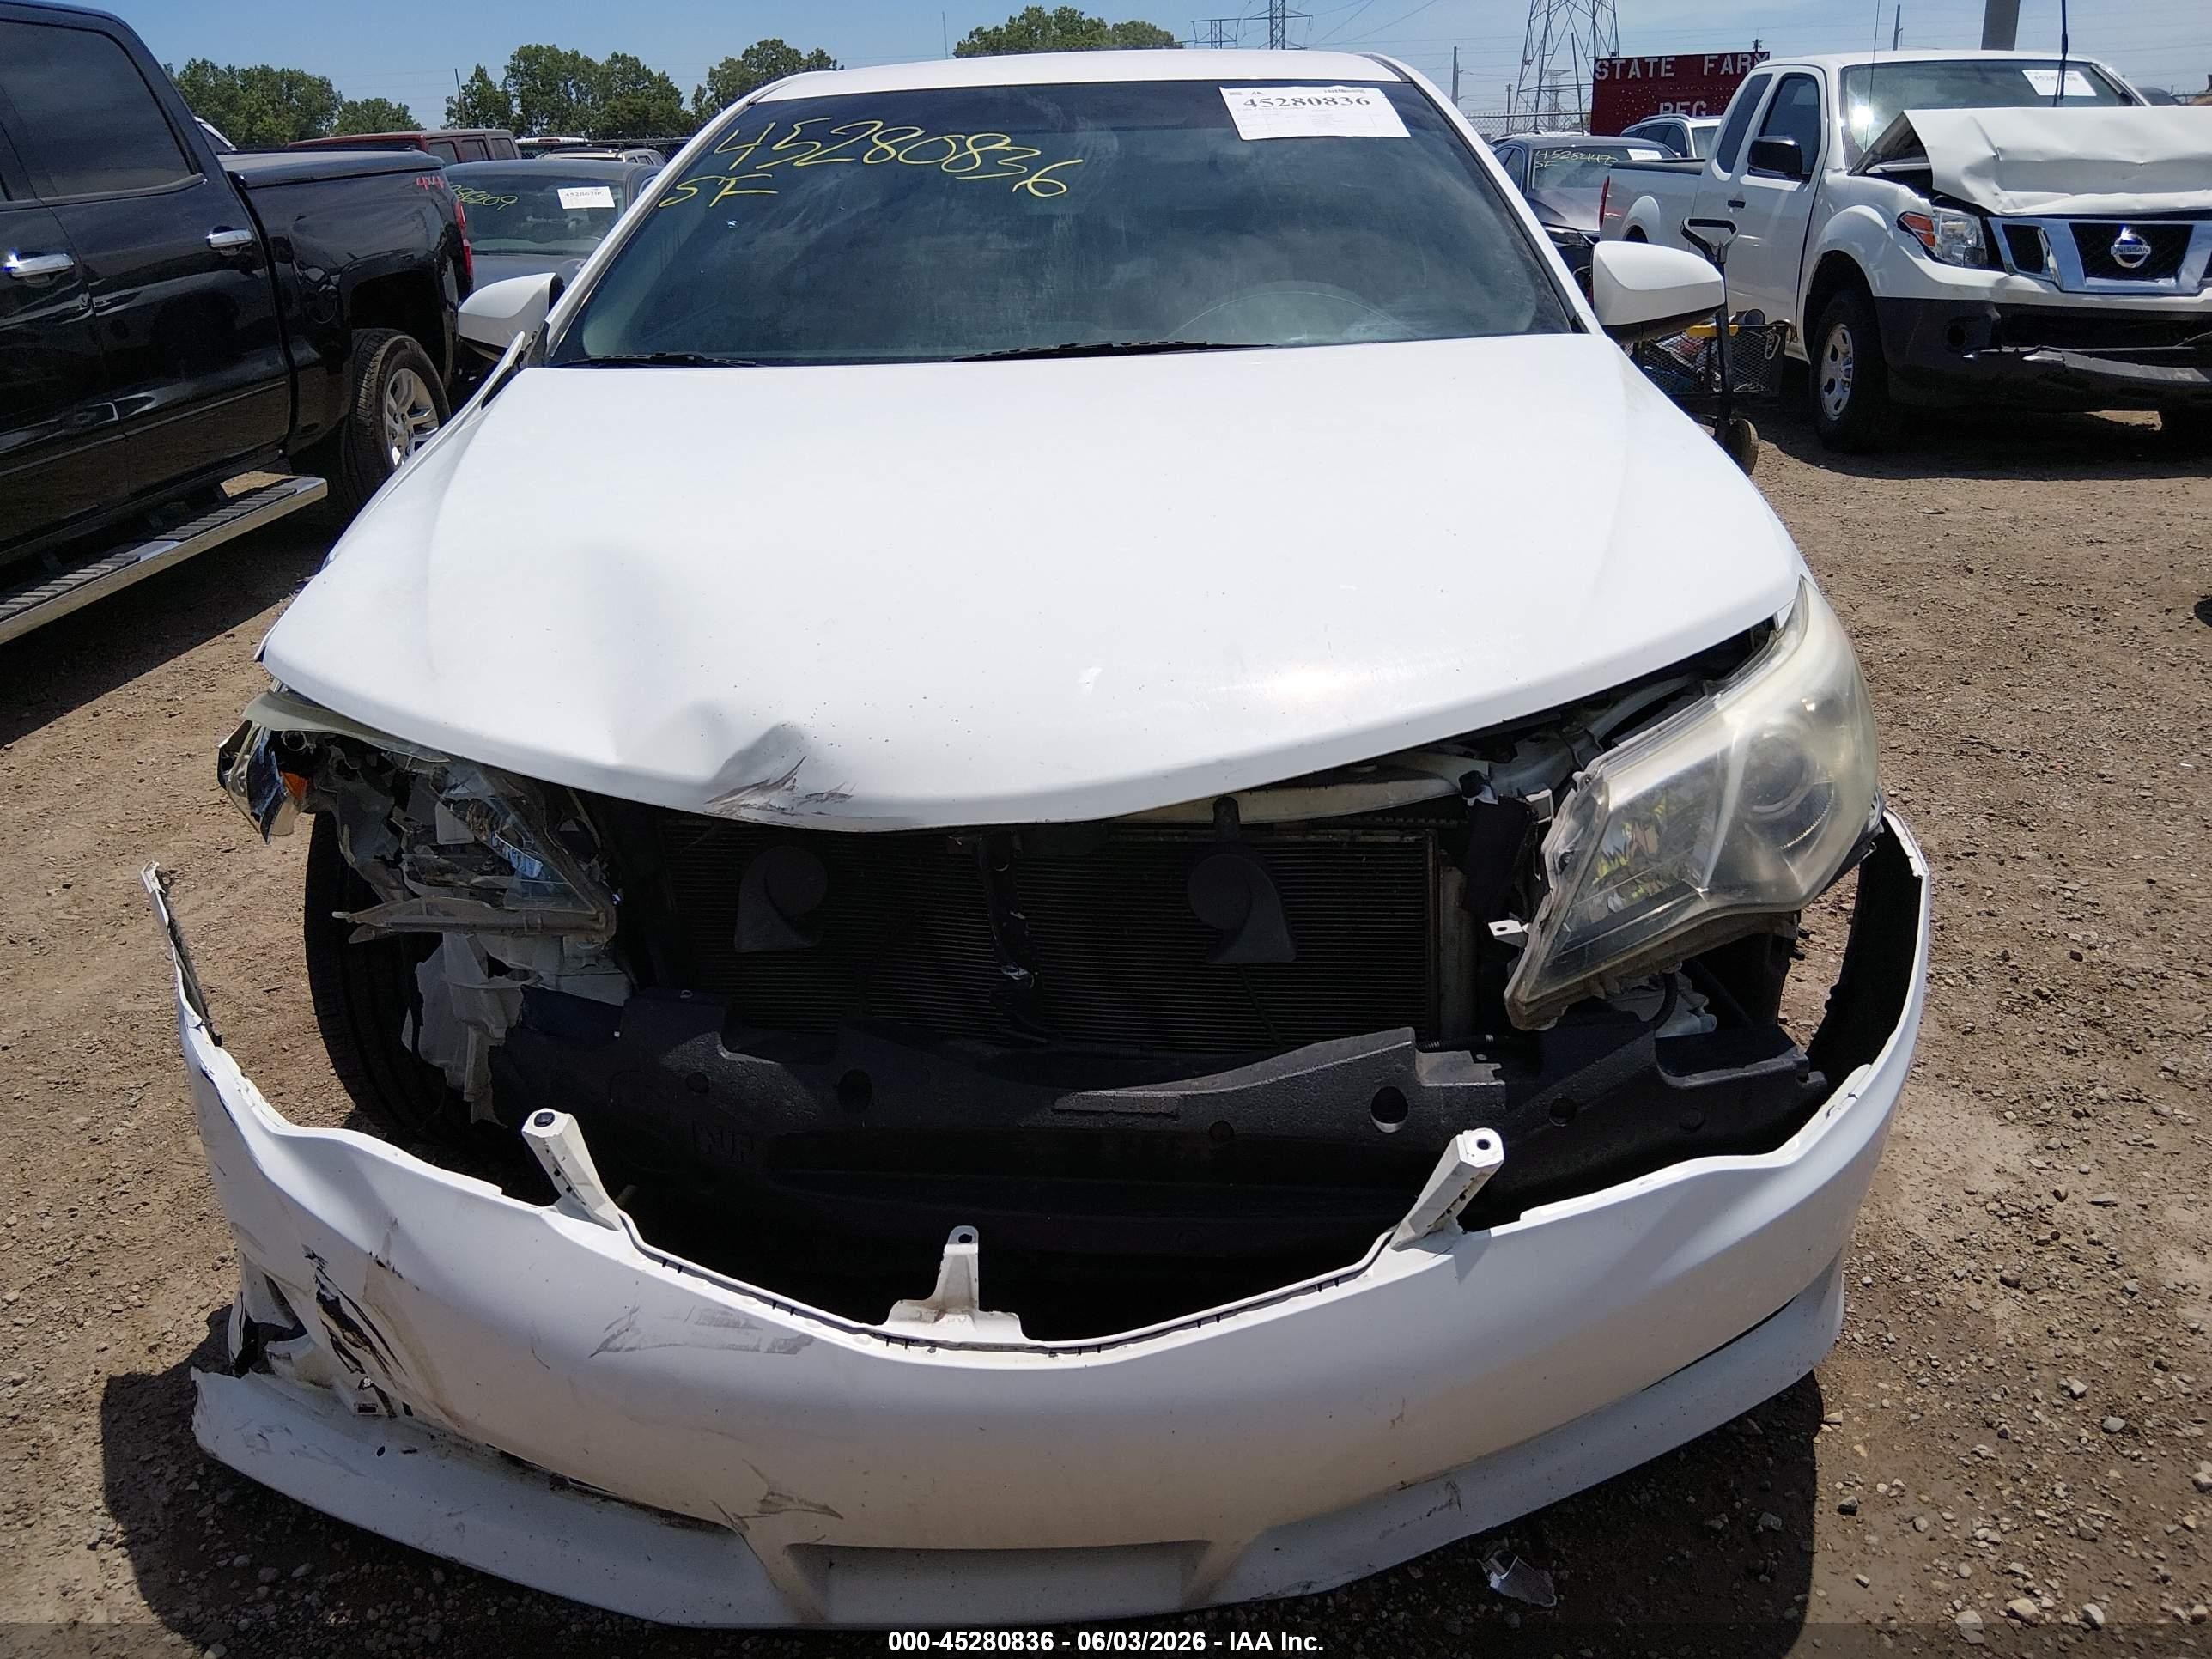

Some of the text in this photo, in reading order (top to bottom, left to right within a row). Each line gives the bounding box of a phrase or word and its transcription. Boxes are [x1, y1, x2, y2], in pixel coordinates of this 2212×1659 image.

[1594, 58, 1674, 80] STATE
[1243, 96, 1371, 108] 45280836
[714, 117, 1083, 198] 45280836
[659, 174, 779, 208] SF
